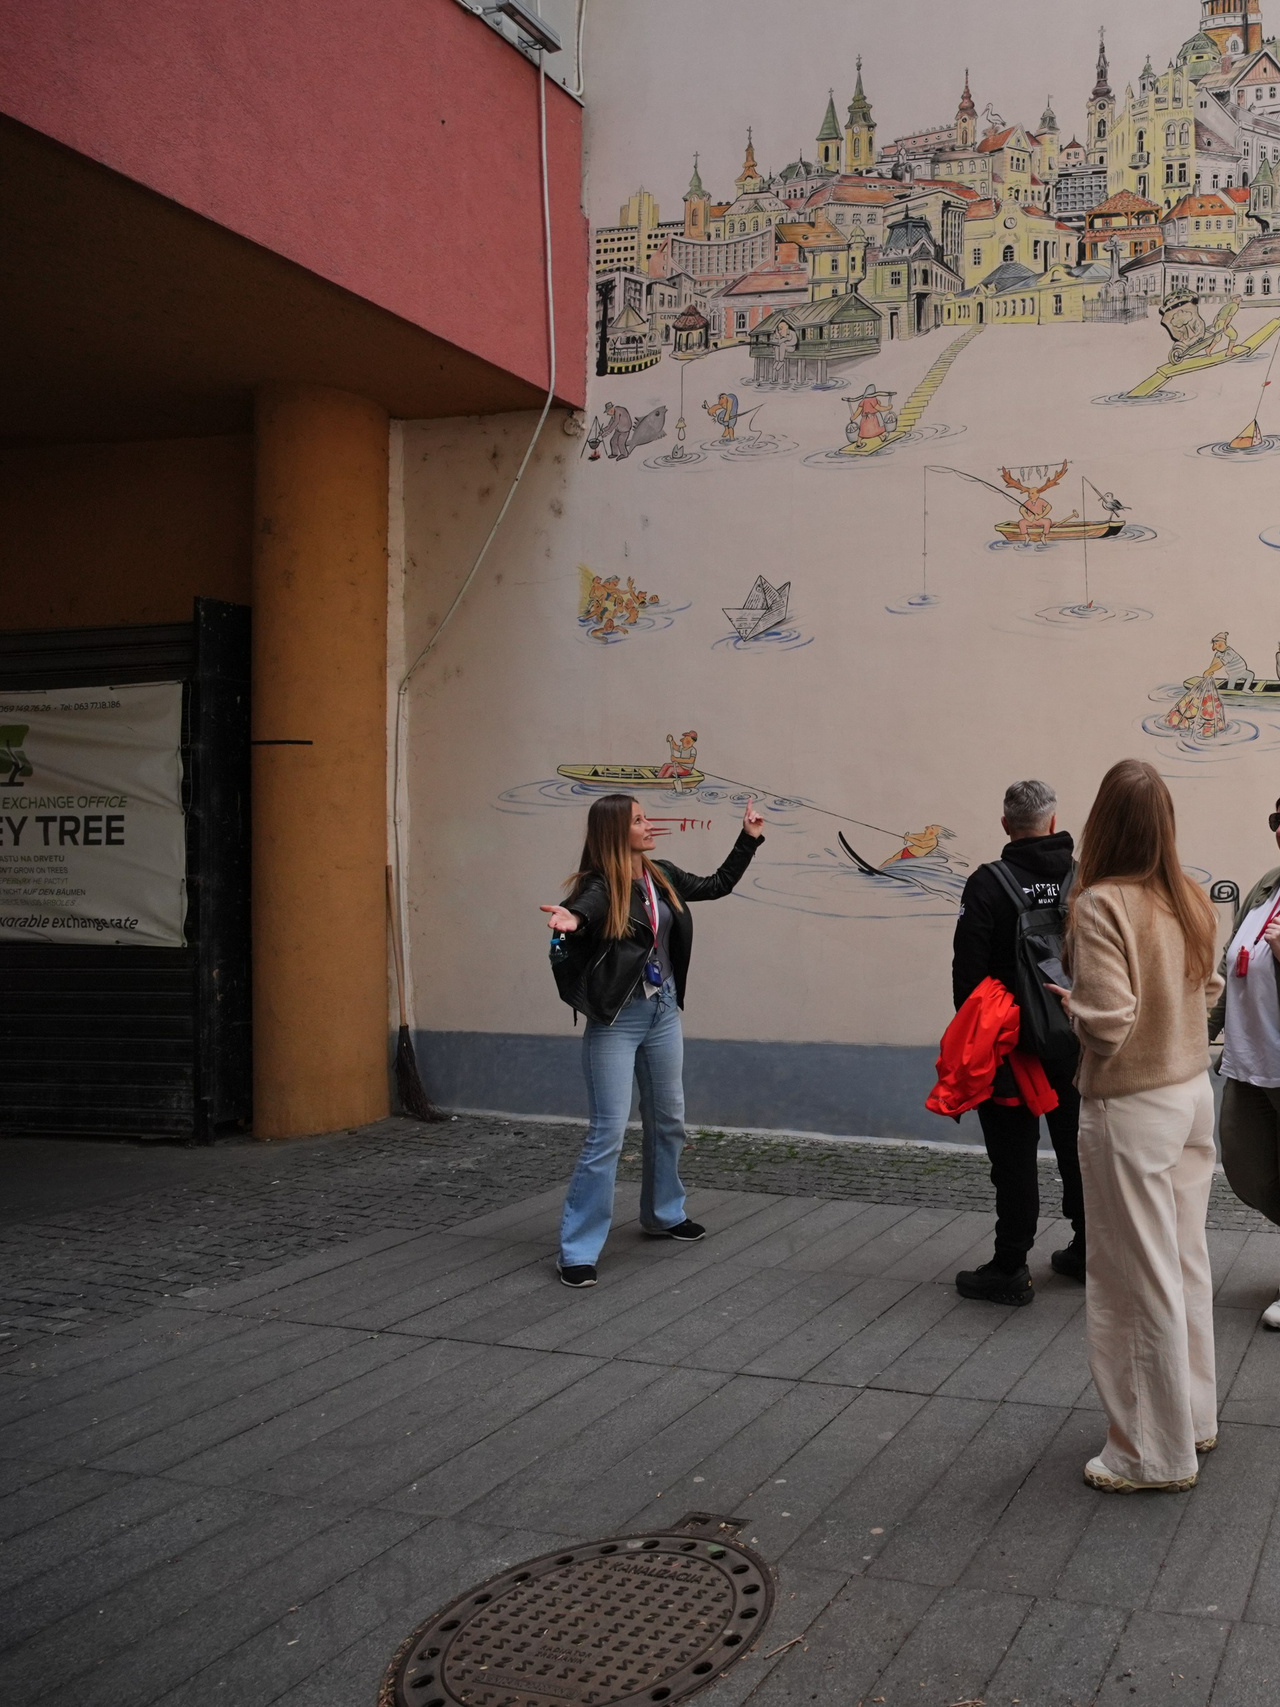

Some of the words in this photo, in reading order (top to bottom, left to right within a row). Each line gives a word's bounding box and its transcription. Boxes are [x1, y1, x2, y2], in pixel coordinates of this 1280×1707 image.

[74, 702, 89, 711] 063
[2, 796, 75, 810] EXCHANGE
[77, 796, 128, 809] OFFICE
[35, 815, 125, 846] TREE
[33, 855, 65, 863] DRVETU
[14, 866, 35, 874] GROW
[36, 866, 46, 874] ON
[47, 866, 69, 874] TREES
[23, 888, 38, 896] AUF
[38, 888, 56, 896] DEN
[51, 914, 109, 932] exchange
[110, 916, 139, 930] rate
[608, 1561, 705, 1585] KANALIZACIJA
